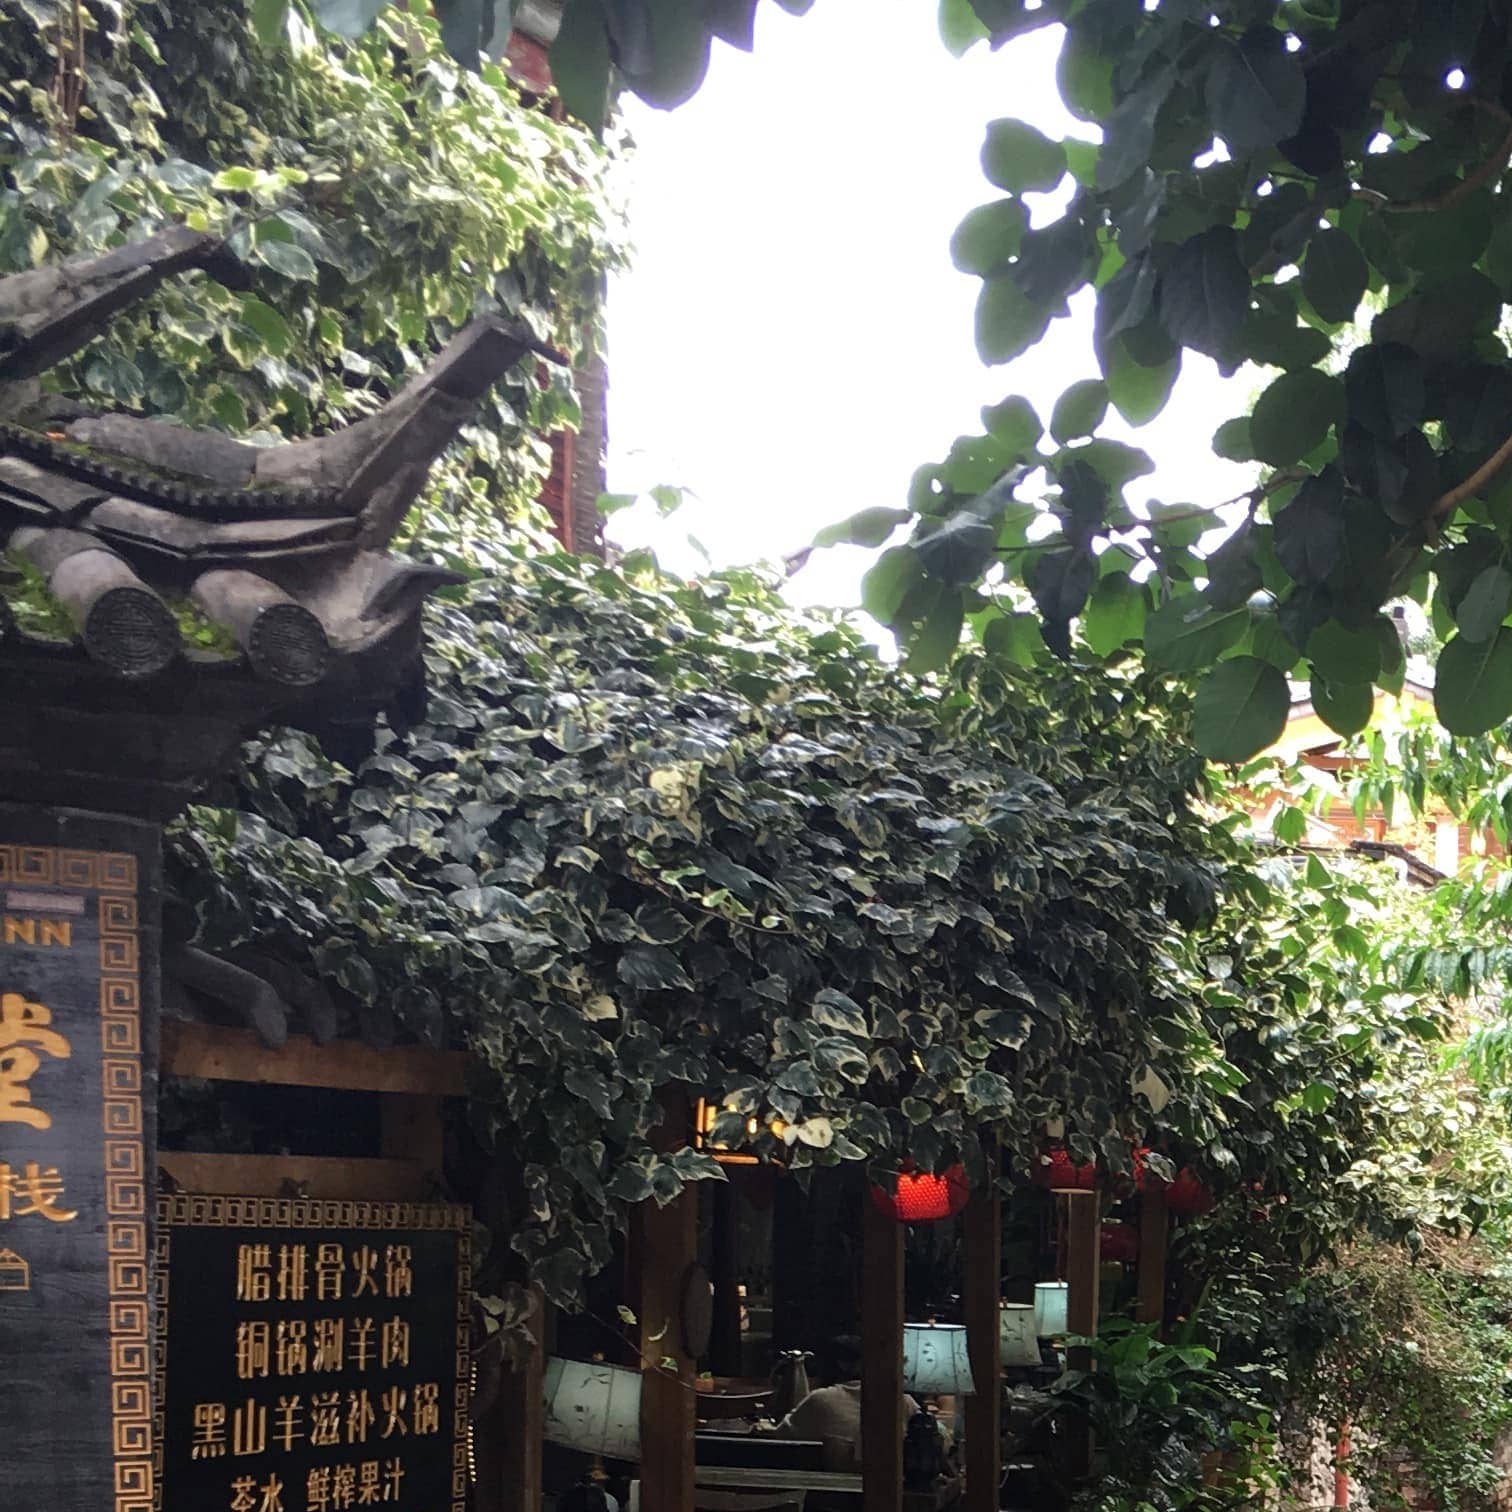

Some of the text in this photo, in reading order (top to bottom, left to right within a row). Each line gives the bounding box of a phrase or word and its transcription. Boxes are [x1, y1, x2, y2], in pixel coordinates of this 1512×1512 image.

[236, 1243, 413, 1301] 腊排骨火锅
[235, 1315, 410, 1379] 铜锅涮羊肉
[191, 1383, 440, 1459] 黑山羊滋补火锅
[306, 1456, 405, 1512] 鲜榨果汁
